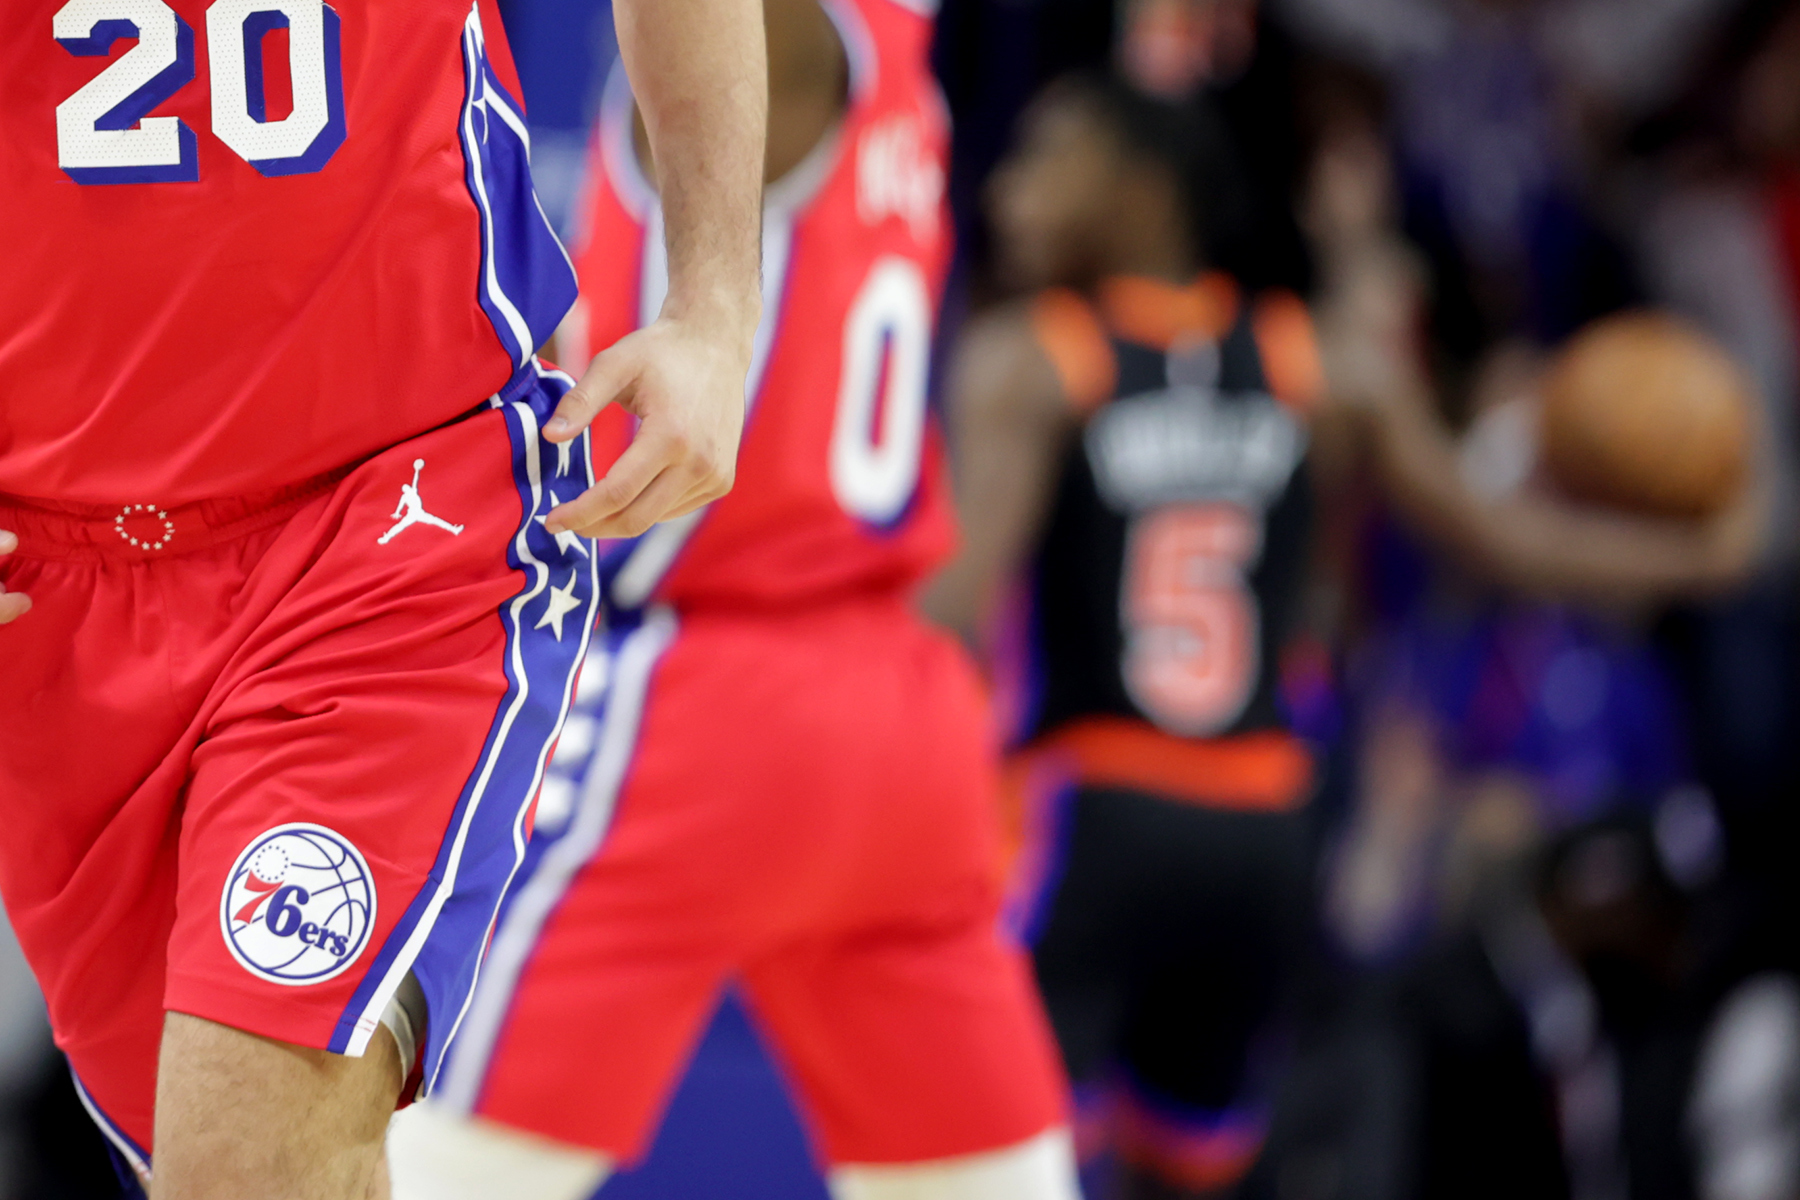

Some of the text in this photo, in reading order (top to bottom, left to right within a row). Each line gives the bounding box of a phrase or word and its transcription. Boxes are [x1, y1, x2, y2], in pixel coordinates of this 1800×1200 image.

[828, 252, 934, 535] 0
[1118, 498, 1266, 740] 5
[232, 866, 349, 957] 76ers
